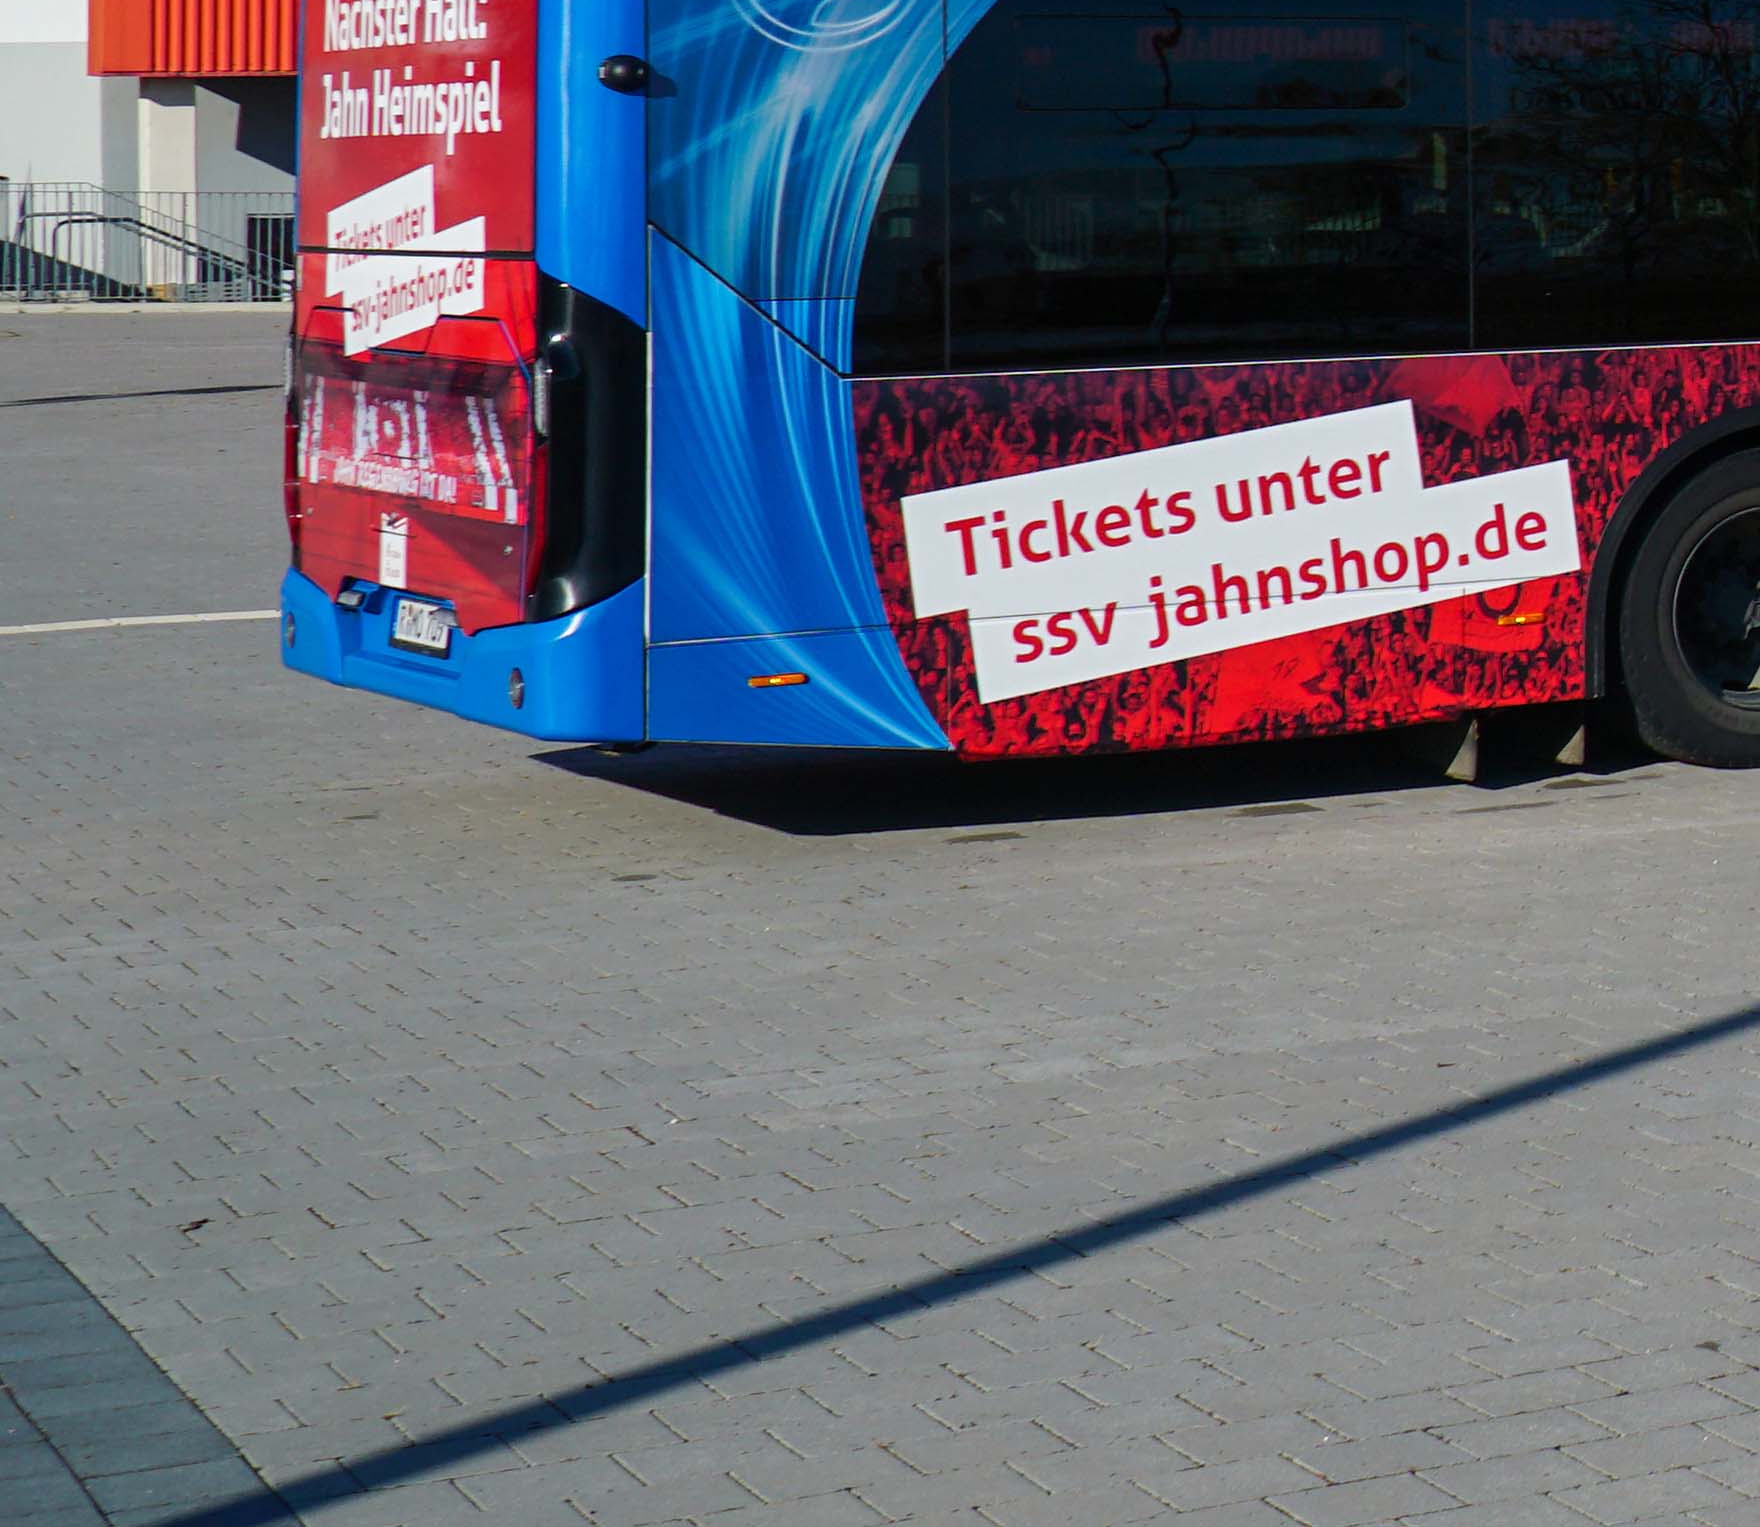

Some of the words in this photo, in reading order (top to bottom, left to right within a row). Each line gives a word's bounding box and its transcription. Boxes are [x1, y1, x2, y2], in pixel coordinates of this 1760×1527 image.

[320, 71, 368, 139] Jahn
[372, 59, 502, 156] Heimspiel
[335, 222, 382, 273] Tickets
[386, 205, 426, 249] unter
[351, 251, 476, 334] ssv-jahnshop.de
[945, 488, 1196, 577] Tickets
[1215, 449, 1391, 523] unter
